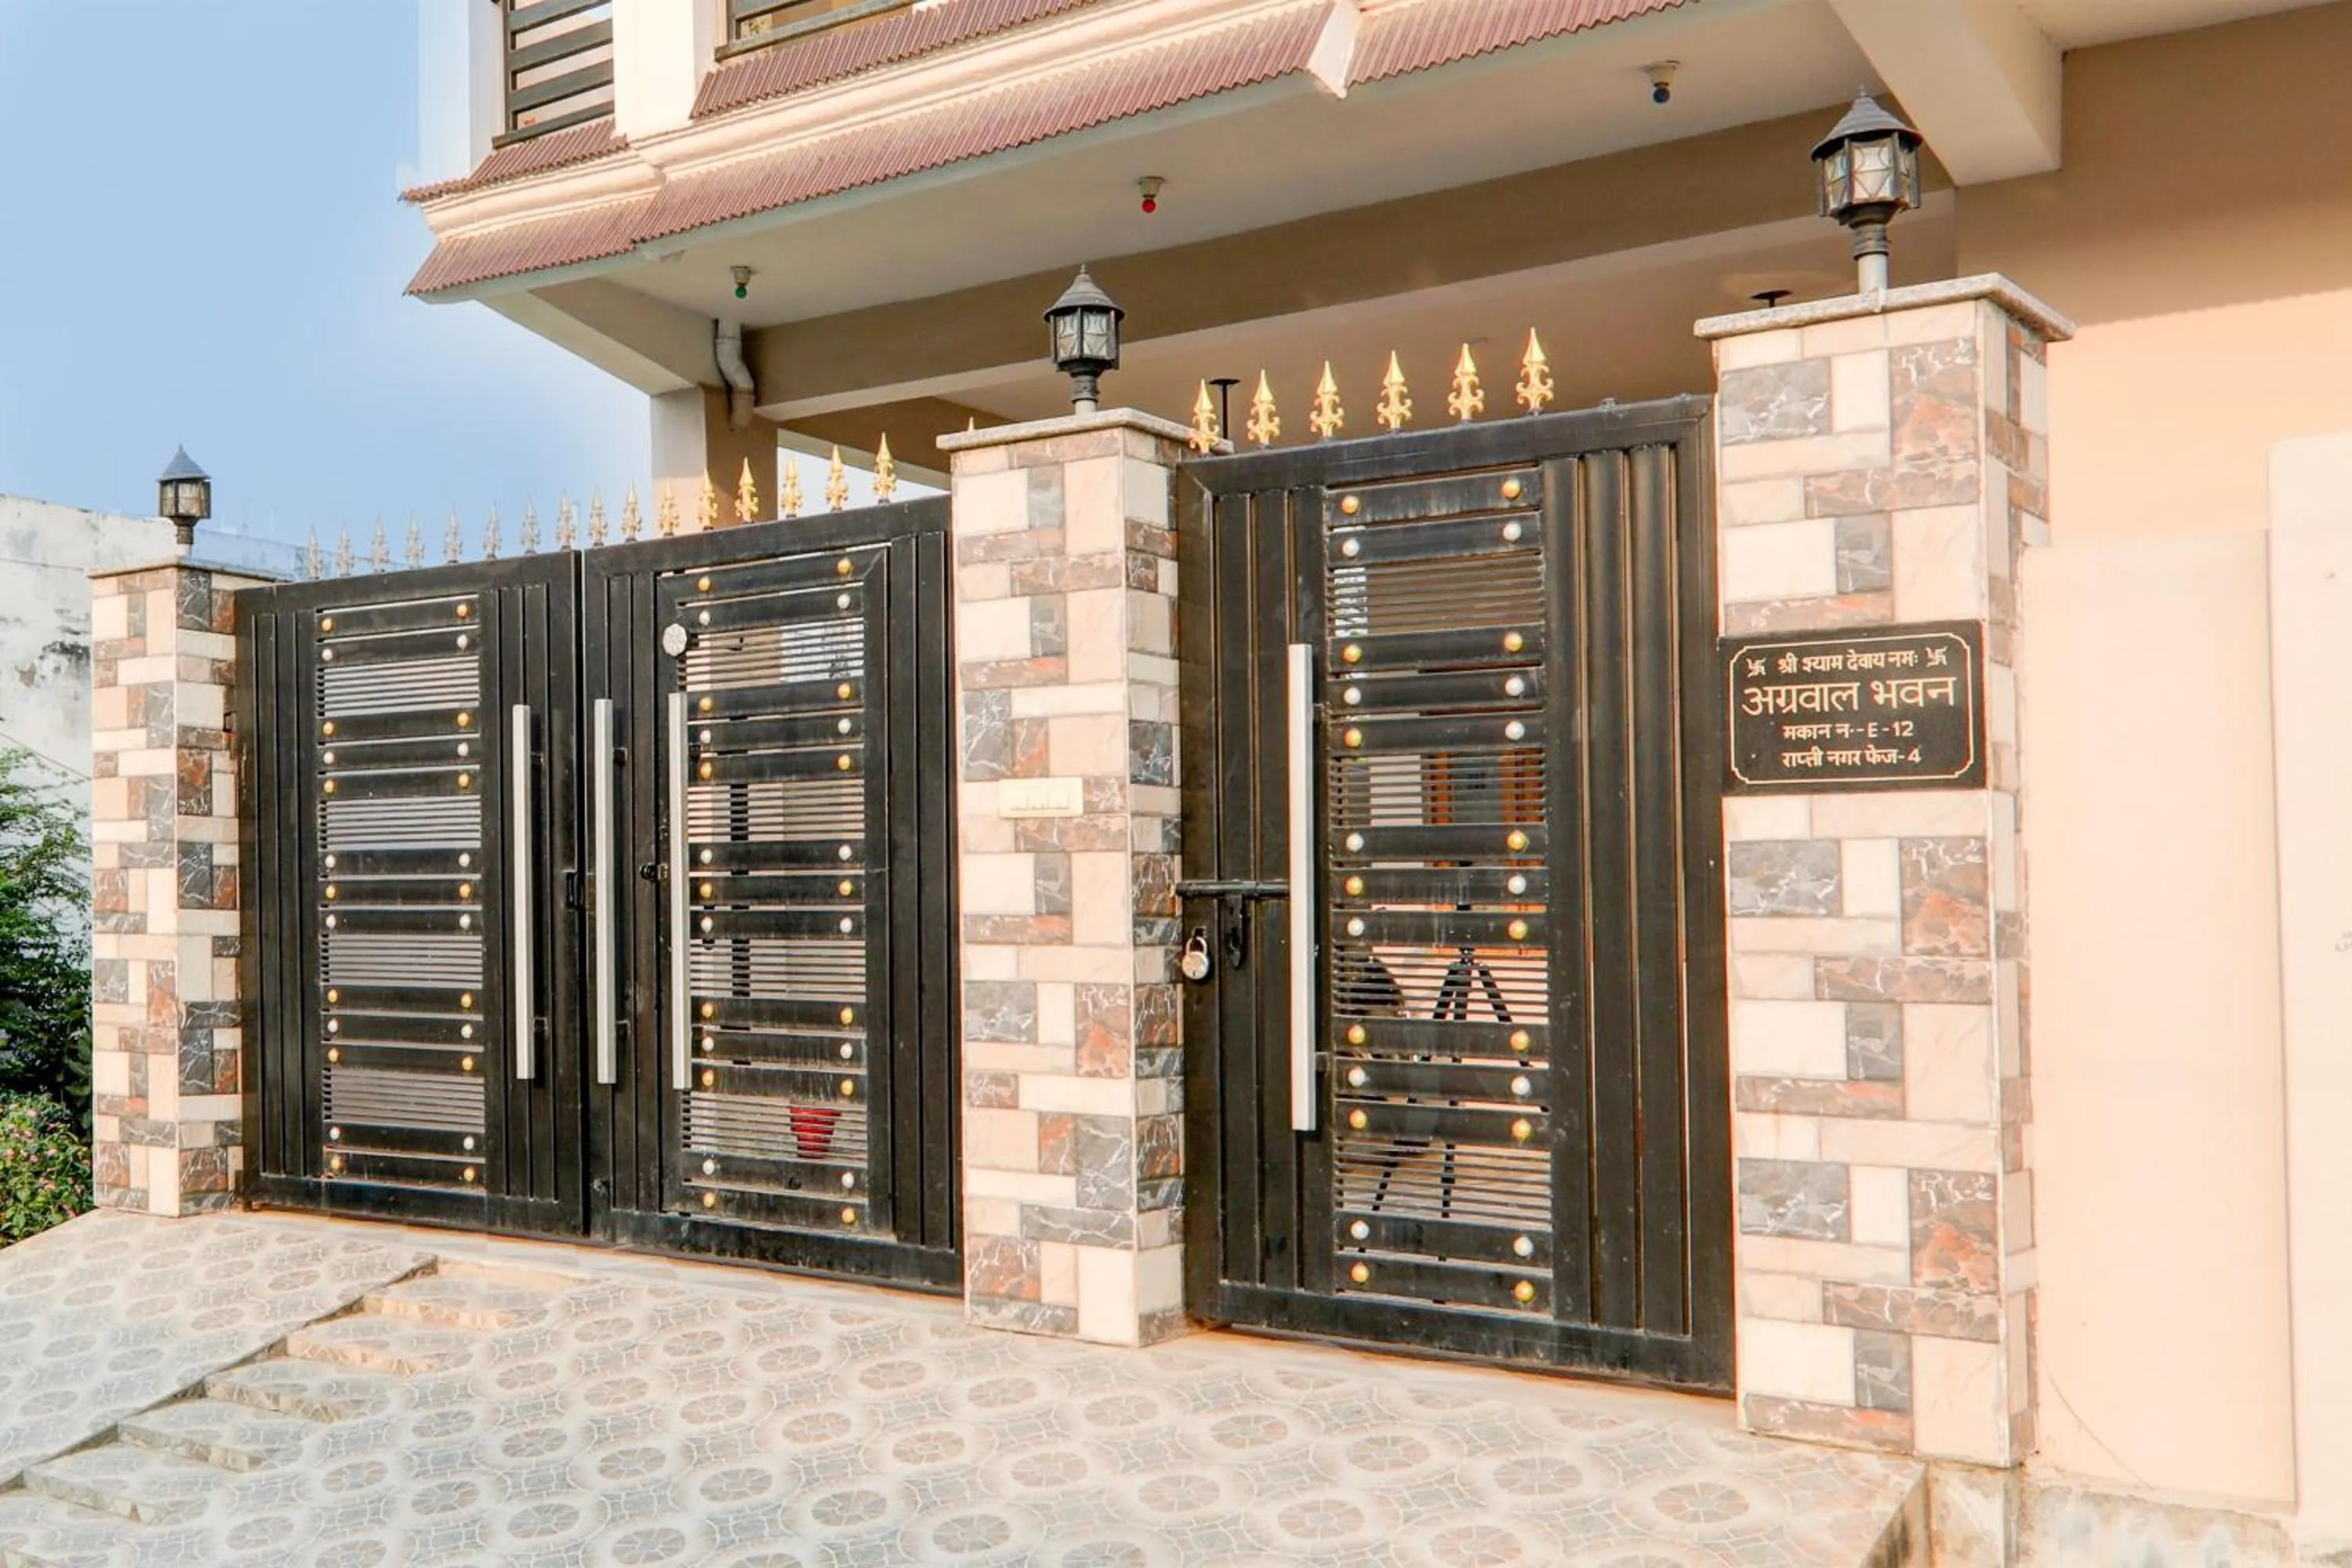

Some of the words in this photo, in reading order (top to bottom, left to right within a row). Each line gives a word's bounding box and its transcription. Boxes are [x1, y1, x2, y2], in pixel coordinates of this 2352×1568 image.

[1778, 652, 1798, 673] श्री
[1802, 655, 1843, 673] श्याम
[1846, 648, 1886, 671] देवाय
[1741, 681, 1860, 716] अग्रवाल
[1870, 677, 1957, 709] भवन
[1782, 724, 1831, 740] मकान
[1781, 746, 1824, 768] राप्ती
[1826, 750, 1862, 766] नगर
